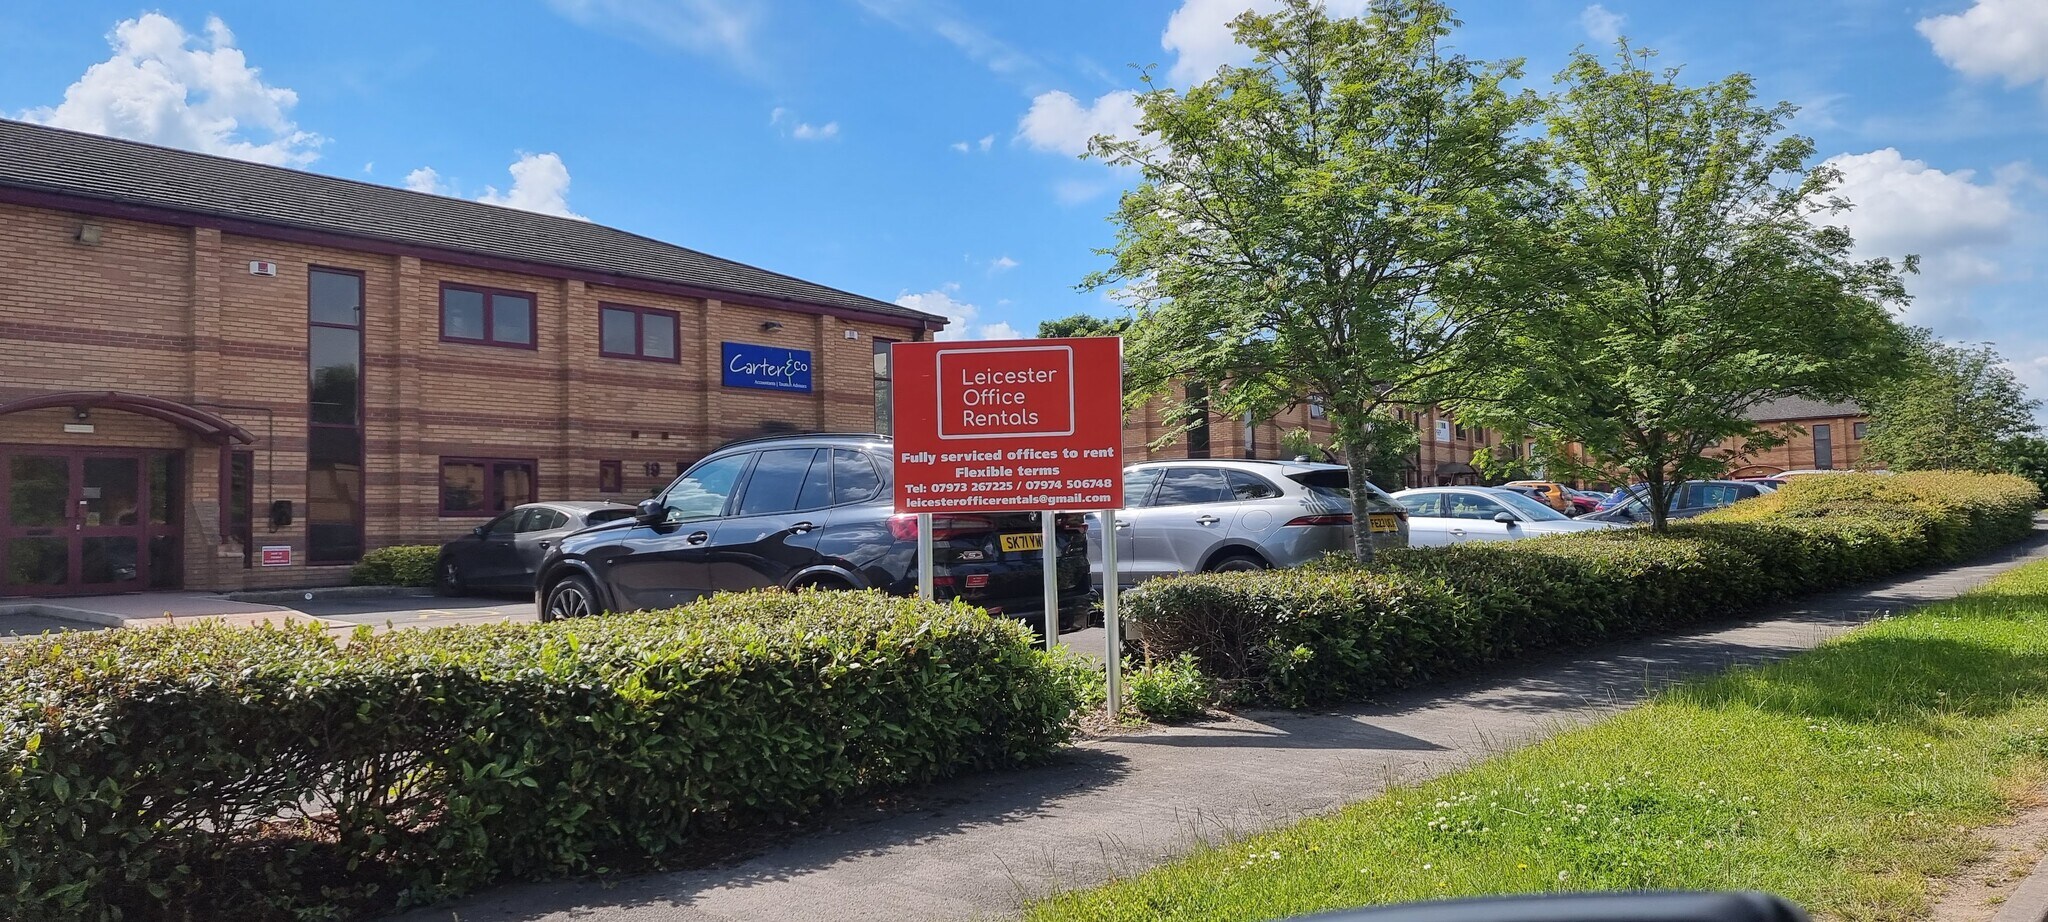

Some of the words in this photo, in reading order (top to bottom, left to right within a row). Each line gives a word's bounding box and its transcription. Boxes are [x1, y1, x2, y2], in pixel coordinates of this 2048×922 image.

[962, 368, 1058, 386] Leicester
[963, 388, 1025, 406] Office
[963, 408, 1039, 427] Rentals
[901, 451, 936, 465] Fully
[940, 449, 1002, 462] serviced
[1006, 448, 1058, 460] offices
[1062, 447, 1078, 459] to
[1083, 447, 1114, 458] rent
[955, 466, 1013, 478] Flexible
[1017, 466, 1060, 476] terms
[904, 483, 927, 494] Tel:
[931, 482, 968, 493] 07973
[971, 481, 1013, 492] 267225
[1025, 480, 1063, 490] 07974
[1066, 479, 1112, 489] 506748
[906, 493, 1111, 508] leicesterofficerentals@gmail.com
